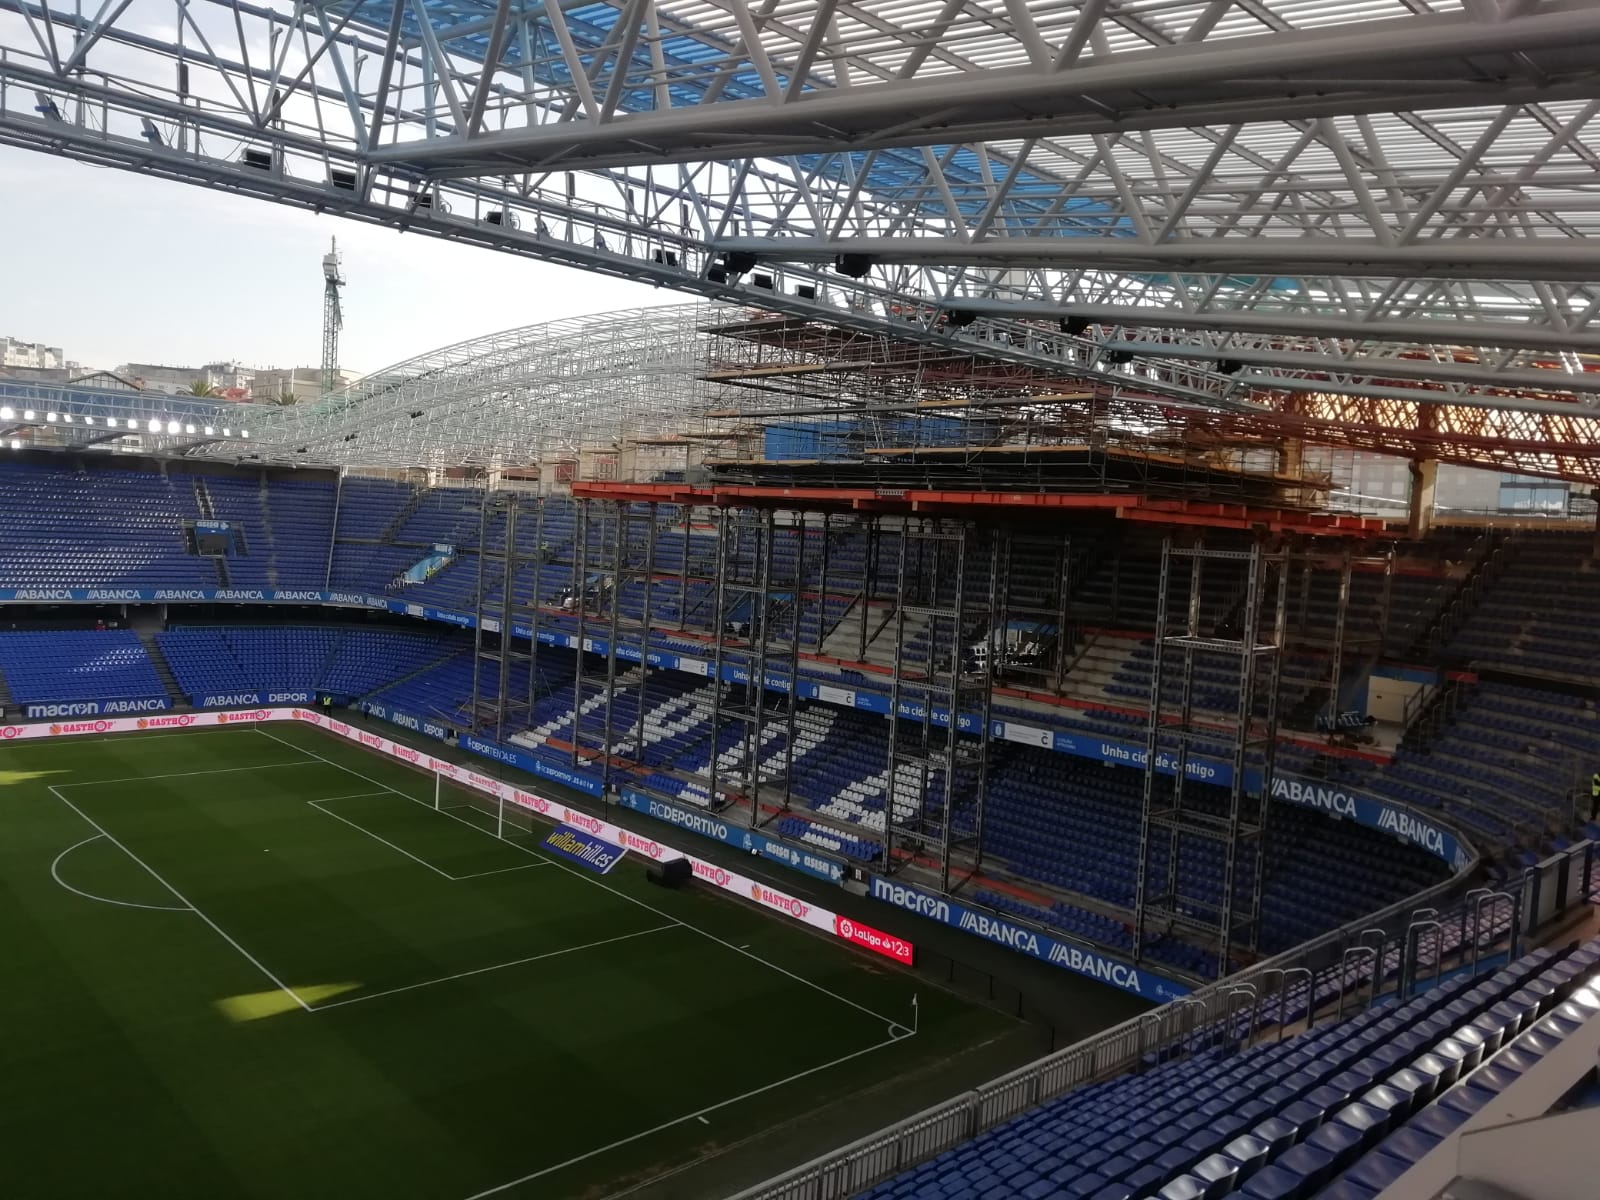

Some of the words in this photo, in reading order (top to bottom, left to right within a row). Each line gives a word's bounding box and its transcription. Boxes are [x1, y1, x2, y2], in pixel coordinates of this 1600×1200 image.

[770, 679, 791, 692] contig
[268, 692, 308, 703] DEPOR
[28, 702, 99, 719] macron
[62, 720, 114, 733] GASTHOF
[149, 715, 197, 727] GASTHOF
[939, 713, 971, 728] coigo
[423, 723, 444, 738] DEPOR
[1101, 743, 1130, 760] Unha
[1131, 751, 1169, 769] cidde
[1171, 759, 1215, 778] cntigo
[649, 800, 728, 840] RCDEPORTIVO
[545, 830, 614, 869] williamhill.es
[765, 841, 792, 860] asisa
[803, 854, 830, 874] asisa
[762, 889, 810, 919] GASTHOF
[874, 878, 950, 924] macron
[853, 929, 882, 947] LaLiga
[891, 940, 910, 957] 123
